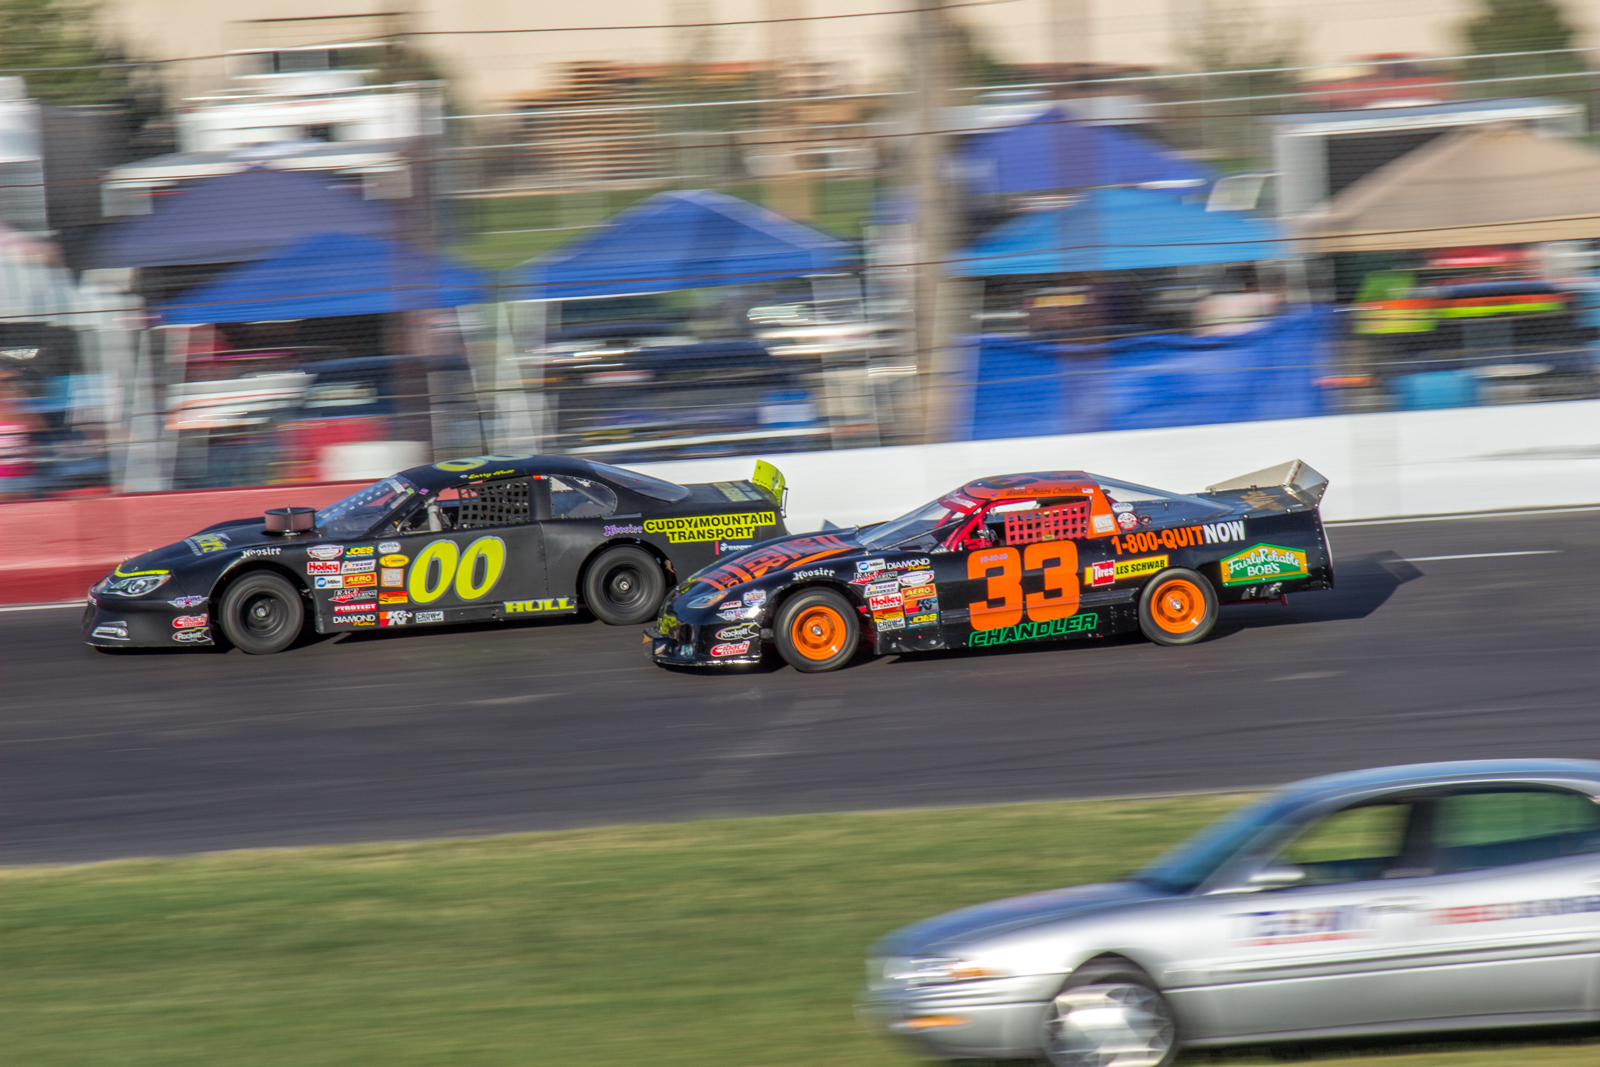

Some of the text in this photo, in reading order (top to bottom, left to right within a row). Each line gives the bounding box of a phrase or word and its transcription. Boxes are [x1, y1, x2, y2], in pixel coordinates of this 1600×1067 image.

[646, 513, 774, 532] CUDDY MOUNTAIN
[603, 524, 643, 536] Hoosier
[669, 527, 752, 541] TRANSPORT
[240, 547, 282, 559] Hoosier
[345, 546, 375, 555] JOES
[308, 562, 339, 573] Holley
[887, 558, 930, 570] DIAMOND
[1116, 559, 1166, 575] LES SCHWAB
[1227, 548, 1301, 575] Fairly Reliable
[407, 535, 507, 606] 00
[793, 567, 835, 581] Hoosier
[1093, 565, 1114, 580] Tires
[905, 587, 931, 596] AERO
[967, 540, 1080, 631] 33
[335, 603, 377, 611] PYROTECT
[505, 598, 575, 613] HULL
[871, 595, 902, 607] Holley
[333, 614, 376, 624] DIAMOND
[909, 613, 938, 624] JOES
[968, 613, 1098, 647] CHANDLER
